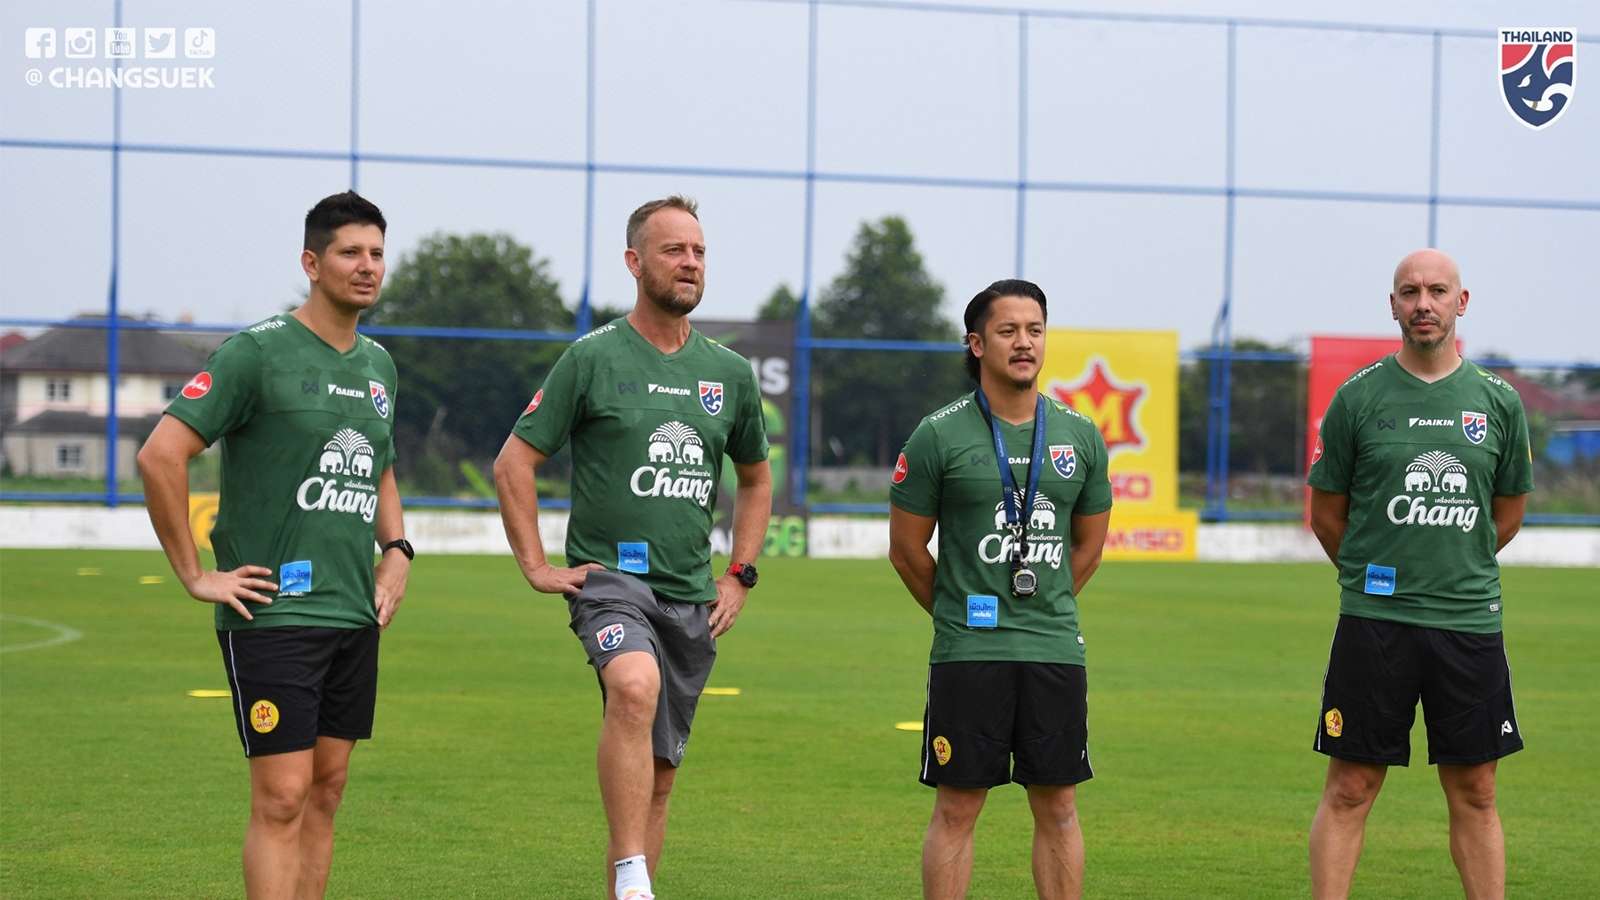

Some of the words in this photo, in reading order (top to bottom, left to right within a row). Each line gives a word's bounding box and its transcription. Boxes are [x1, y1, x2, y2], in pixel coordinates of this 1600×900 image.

[336, 387, 365, 399] DAIKIN
[657, 386, 691, 396] DAIKIN
[930, 400, 970, 422] TOYOTA
[1418, 418, 1455, 428] DAIKIN
[630, 466, 713, 507] Chang
[297, 476, 378, 523] Chang
[1386, 495, 1480, 533] Chang
